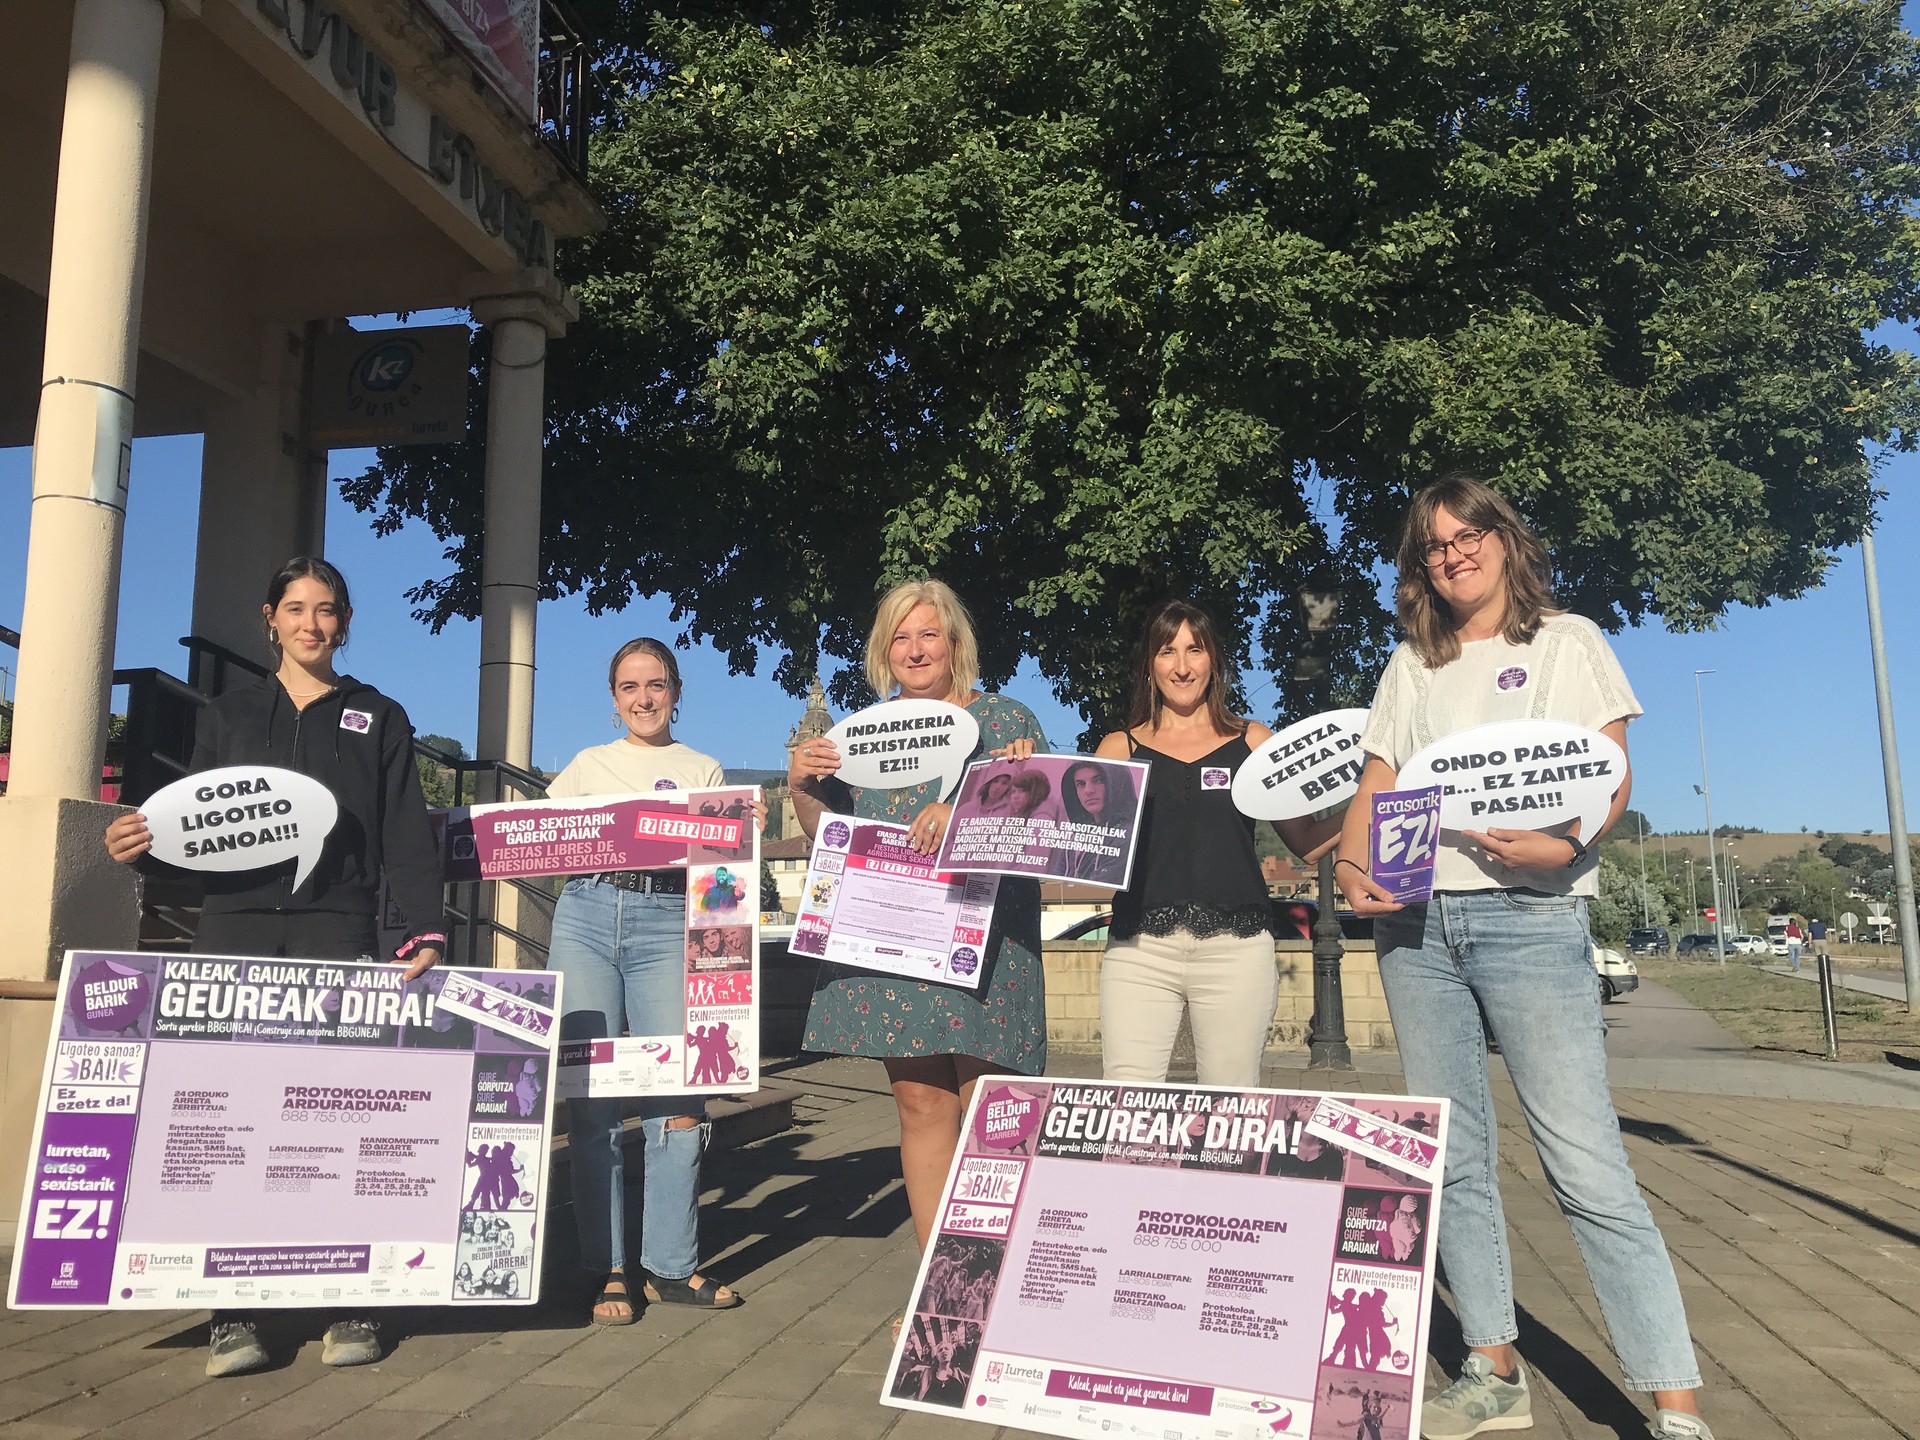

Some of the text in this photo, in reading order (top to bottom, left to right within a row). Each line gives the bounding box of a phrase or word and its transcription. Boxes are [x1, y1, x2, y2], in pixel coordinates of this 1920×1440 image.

[846, 714, 955, 738] INDARKERIA
[848, 733, 951, 756] SEXISTARIK
[1268, 722, 1342, 764] EZETZA
[1261, 747, 1336, 790] EZETZA
[1335, 732, 1362, 751] DA
[1430, 738, 1590, 774] ONDO PASA!
[879, 756, 919, 774] EZ!!!
[1482, 773, 1516, 790] EZ
[1520, 760, 1613, 786] ZAITEZ
[194, 777, 272, 803] GORA
[1376, 791, 1440, 814] erasorik
[1470, 791, 1565, 816] PASA!!!
[180, 799, 292, 832] LIGOTEO
[493, 811, 616, 835] ERASO SEXISTARIK
[505, 826, 601, 846] GABEKO JAIAK
[640, 815, 722, 840] EZ EZETZ DA
[876, 830, 898, 840] ERASO
[956, 825, 1105, 845] LAGUNTZEN DITUZUE. ZERBAIT EGITEN
[959, 817, 1127, 839] EZ BADUZUE EZER EGITEN, ERASOTZAILEAK
[183, 823, 299, 858] SANOA!!!
[881, 837, 907, 848] GABEKO
[1378, 809, 1438, 865] EZ!
[492, 840, 616, 860] FIESTAS LIBRES DE
[873, 843, 899, 854] FIESTAS
[951, 843, 1025, 854] LAGUNTZEN DUZUE.
[954, 834, 1121, 858] BADUZUE MATXISMOA DESAGERRARAZTEN
[480, 852, 627, 874] AGRESIONES SEXISTAS
[866, 859, 878, 869] EZ
[880, 862, 911, 874] EZETZ
[949, 851, 1049, 866] NOR LAGUNDUKO DUZUE?
[164, 962, 403, 990] KALEAK, GAUAK ETA JAIAK
[84, 976, 139, 997] BELDUR
[85, 991, 128, 1011] BARIK
[159, 983, 435, 1027] GEUREAK DIRA!
[86, 1008, 115, 1020] GUNEA
[690, 1010, 709, 1022] EKIN
[156, 1019, 178, 1031] Sortu
[178, 1022, 206, 1037] gurekin
[207, 1021, 252, 1034] BBGUNEA!
[293, 1027, 306, 1037] con
[307, 1025, 336, 1038] nosotras
[337, 1025, 380, 1039] BBGUNEA!
[60, 1042, 142, 1060] Ligoteo sanoa?
[478, 1071, 497, 1082] GURE
[57, 1088, 77, 1100] Ez
[174, 1090, 230, 1099] 24 ORDUKO
[284, 1086, 432, 1102] PROTOKOLOAREN
[477, 1082, 514, 1093] GORPUTZA
[56, 1094, 131, 1111] ezetz da!
[282, 1098, 408, 1113] ARDURADUNA:
[476, 1092, 495, 1103] GURE
[1052, 1087, 1270, 1116] KALEAK, GAUAK ETA JAIAK
[171, 1104, 228, 1112] ZERBITZUA:
[475, 1101, 507, 1114] ARAUAK!
[986, 1101, 1031, 1120] BELDUR
[281, 1110, 371, 1124] 688 755 000
[985, 1116, 1020, 1133] BARIK
[472, 1127, 493, 1140] EKIN
[985, 1129, 1020, 1142] #JARRERA
[1044, 1106, 1198, 1148] GEUREAK
[1203, 1116, 1303, 1155] DIRA!
[268, 1145, 345, 1154] LARRIALDIETAN:
[360, 1137, 440, 1146] MANKOMUNITATE
[46, 1144, 111, 1161] Iurretan,
[1040, 1140, 1057, 1151] Sortu
[1058, 1143, 1081, 1156] gurekin
[1082, 1141, 1122, 1156] BBGUNEA!
[1160, 1149, 1170, 1159] con
[1171, 1149, 1199, 1162] nosotras
[1199, 1150, 1244, 1165] BBGUNEA!
[43, 1162, 86, 1174] eraso
[961, 1158, 1023, 1176] Ligoteo sanoa?
[40, 1177, 115, 1192] sexistarik
[971, 1174, 1003, 1199] BAI!
[33, 1199, 113, 1240] EZ!
[952, 1205, 967, 1217] Ez
[1347, 1206, 1369, 1219] GURE
[949, 1215, 1009, 1229] ezetz da!
[1138, 1209, 1288, 1233] PROTOKOLOAREN
[1345, 1217, 1387, 1232] GORPUTZA
[1135, 1222, 1261, 1244] ARDURADUNA:
[1343, 1229, 1365, 1242] GURE
[1133, 1233, 1222, 1253] 688 755 000
[1341, 1240, 1380, 1255] ARAUAK!
[149, 1253, 193, 1265] Iurreta
[488, 1255, 529, 1271] JARRERA!
[51, 1278, 79, 1287] Iurreta
[1118, 1268, 1193, 1284] LARRIALDIETAN:
[1209, 1267, 1295, 1283] MANKOMUNITATE
[1336, 1267, 1361, 1284] EKIN
[1114, 1289, 1166, 1301] IURRETAKO
[1113, 1296, 1187, 1312] UDALTZAINGOA:
[1004, 1363, 1044, 1381] Iurreta
[1092, 1379, 1113, 1399] gauak
[1113, 1384, 1124, 1396] eta
[1124, 1383, 1143, 1403] jaiak
[1142, 1386, 1171, 1406] geureak
[1171, 1387, 1190, 1405] dira!
